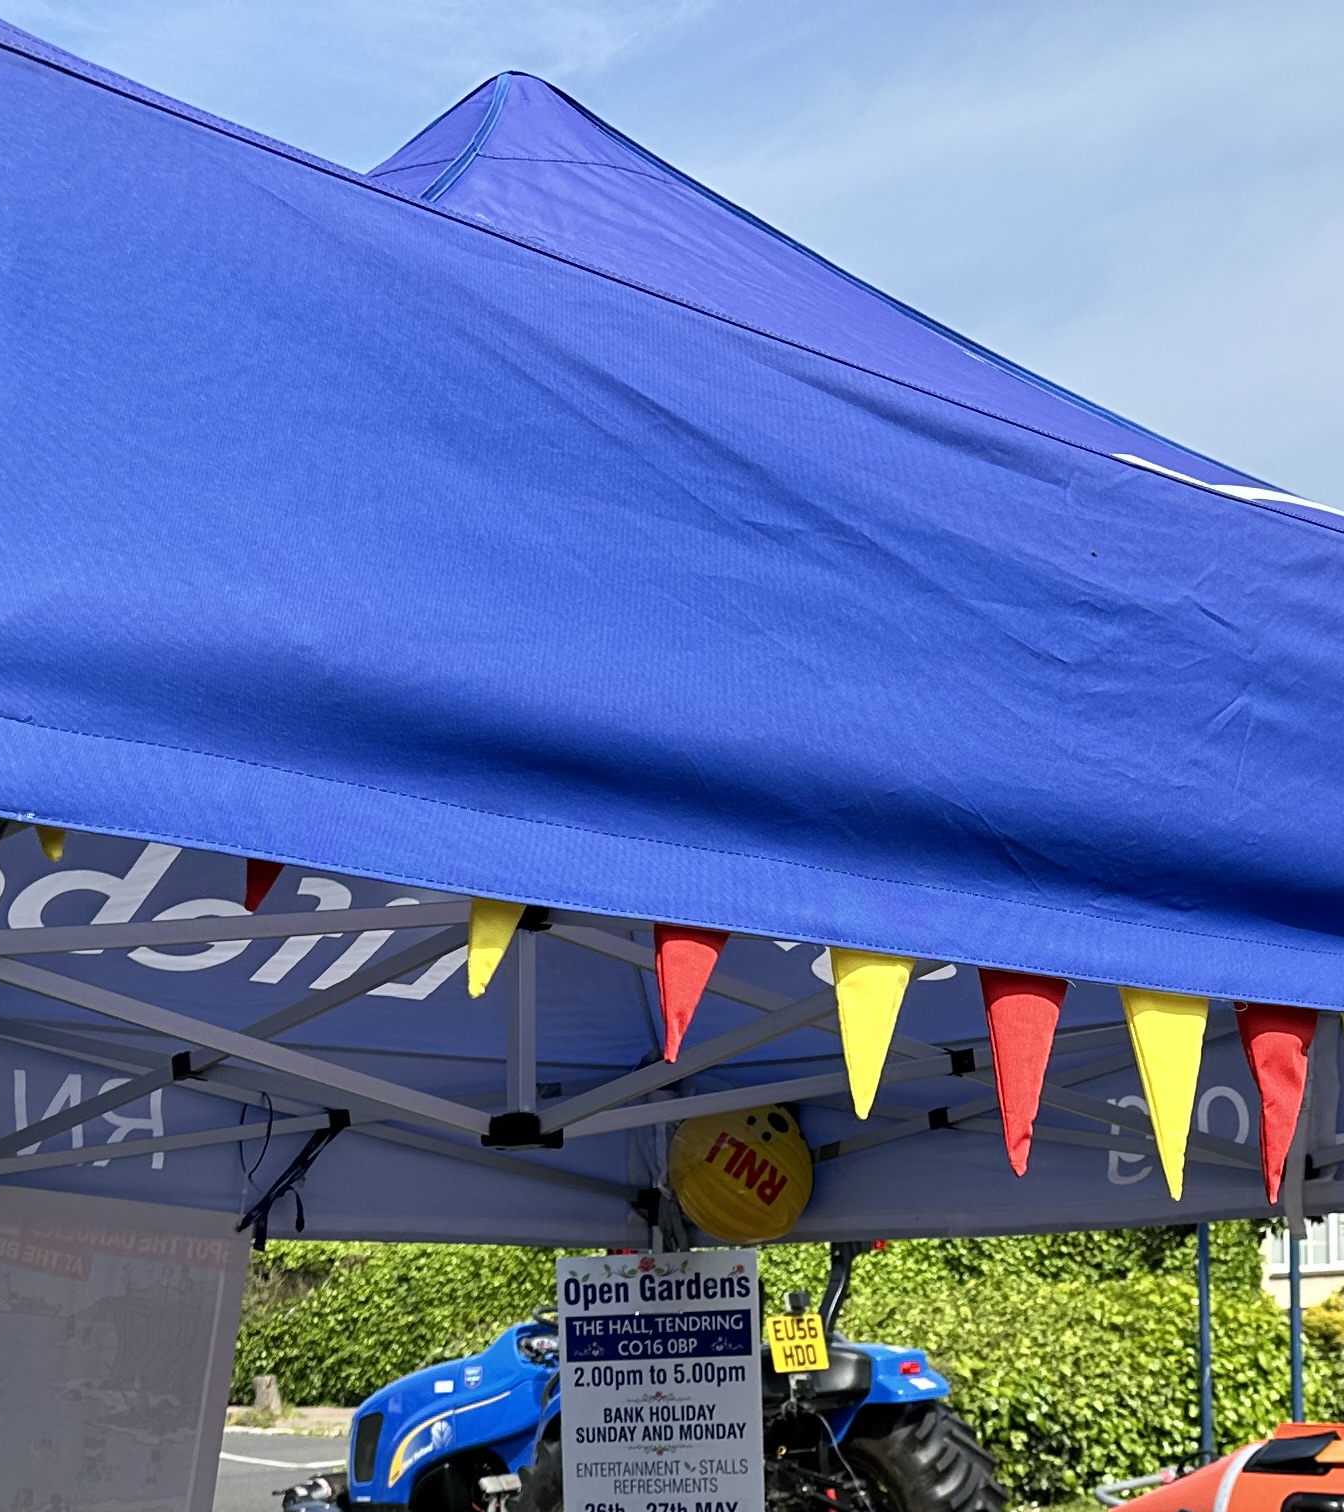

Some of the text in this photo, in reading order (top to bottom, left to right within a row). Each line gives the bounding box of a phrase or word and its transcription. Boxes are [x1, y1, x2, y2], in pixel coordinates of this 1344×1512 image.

[705, 1131, 788, 1207] RNLI
[564, 1272, 751, 1311] Open Gardens
[572, 1314, 743, 1336] THE HALL, TENDRING
[772, 1318, 818, 1342] EU56
[617, 1340, 663, 1356] CO16
[574, 1362, 746, 1390] 2.00pm to 5.00pm
[603, 1404, 716, 1424] BANK HOLIDAY
[575, 1422, 747, 1444] SUNDAY AND MONDAY
[576, 1458, 749, 1478] ENTERTAINMENT STALLS
[614, 1477, 718, 1495] REFRESHMENTS
